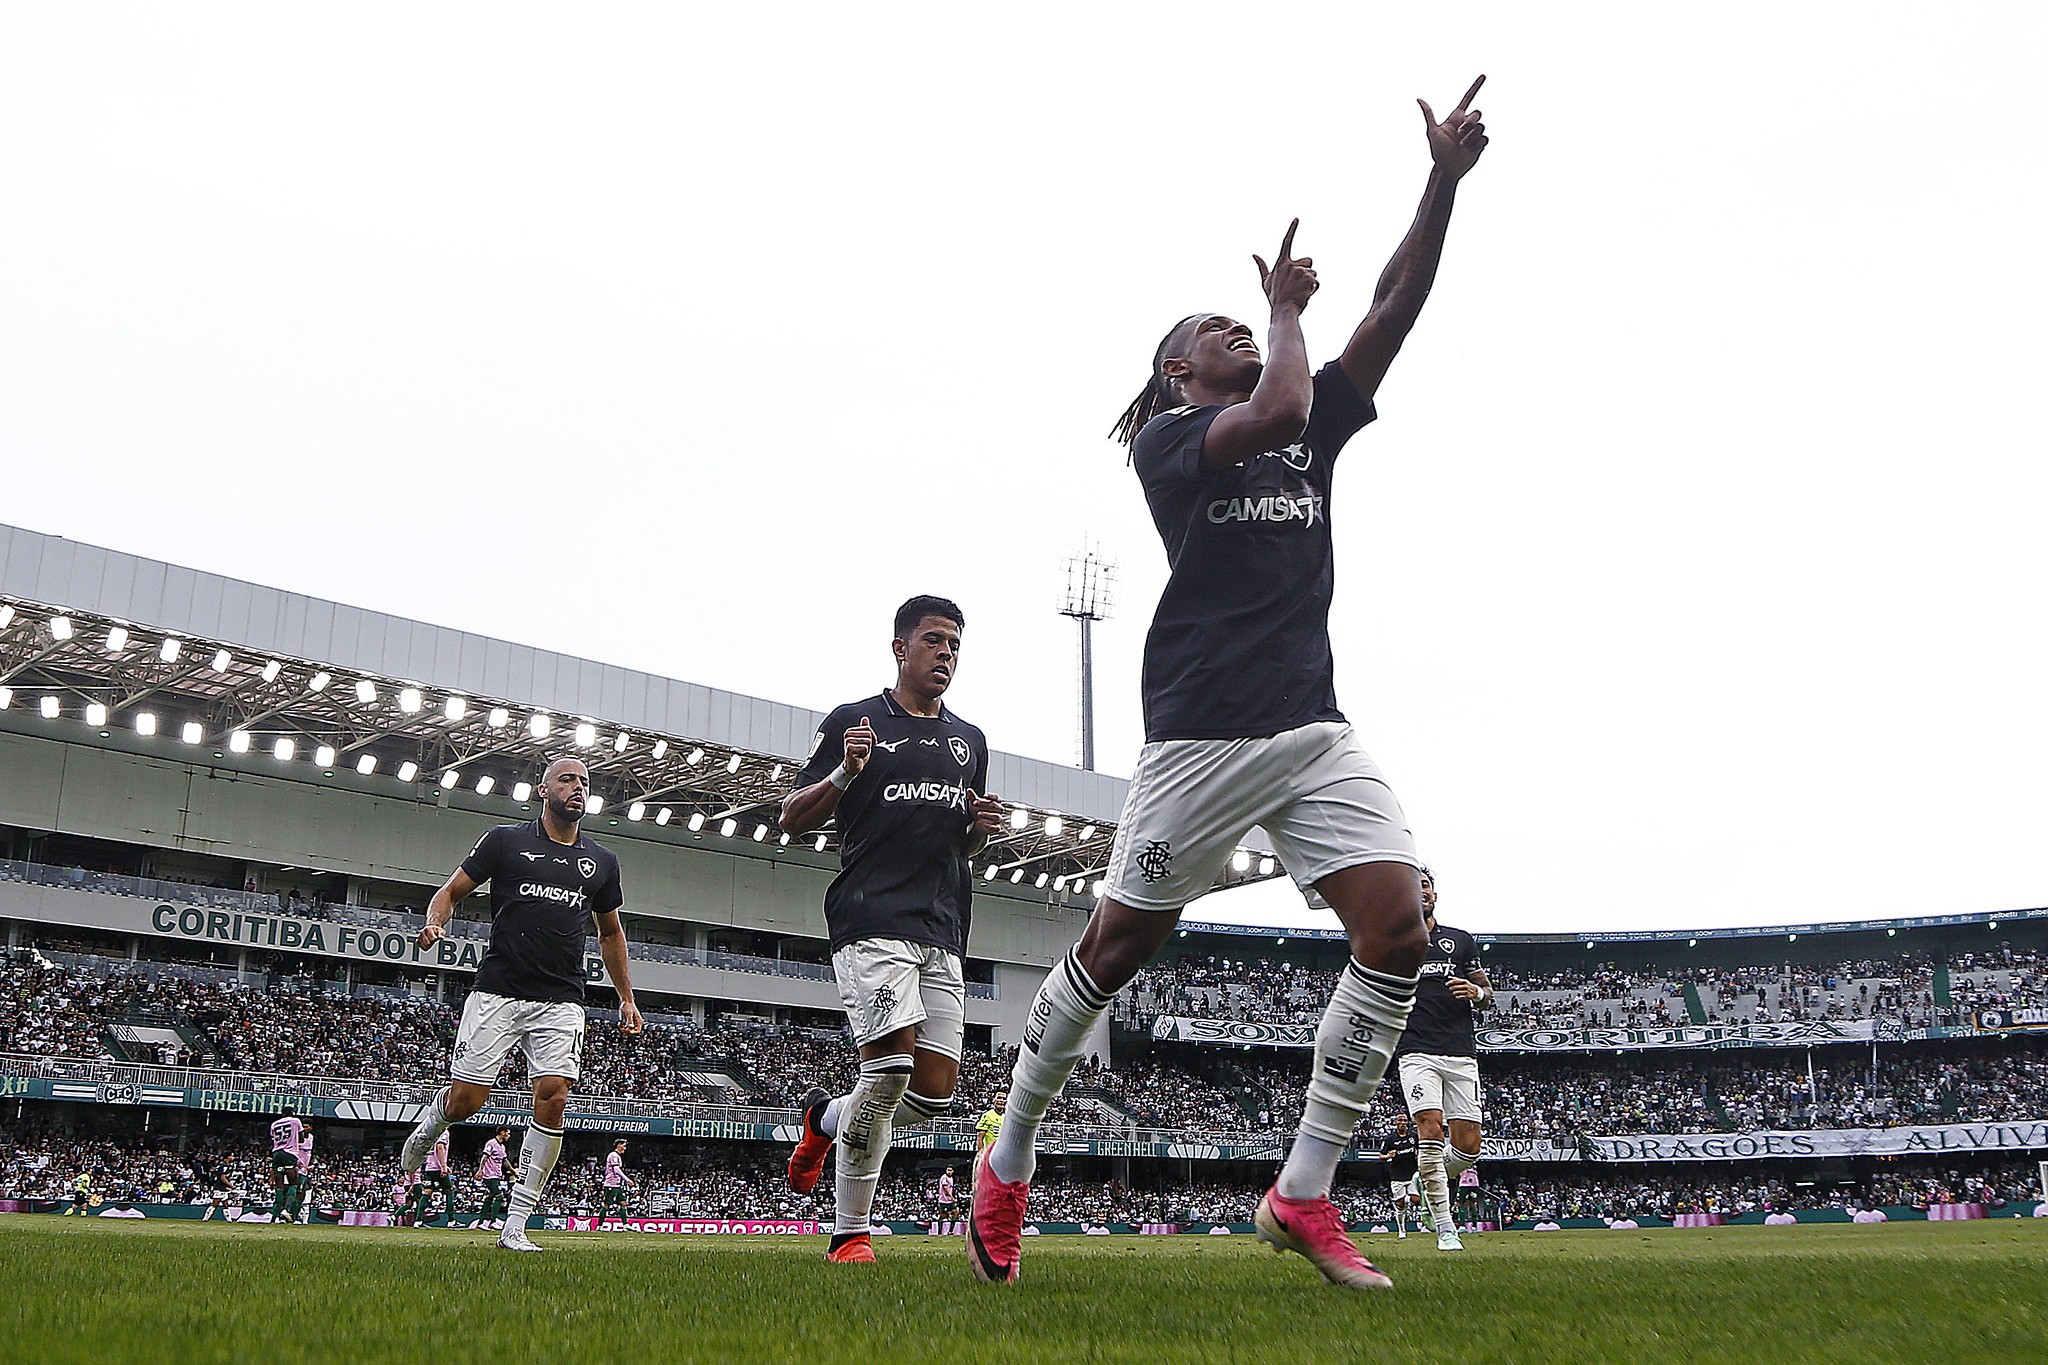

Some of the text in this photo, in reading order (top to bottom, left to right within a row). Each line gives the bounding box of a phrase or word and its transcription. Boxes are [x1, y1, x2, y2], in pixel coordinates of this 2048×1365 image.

[152, 904, 327, 951] CORITIBA
[1188, 1020, 1317, 1044] SOM
[106, 1087, 132, 1100] CFC
[200, 1089, 266, 1113] GREEN
[274, 1123, 292, 1141] 55
[464, 1110, 506, 1126] ESTÁDIO
[506, 1114, 534, 1128] MAJO
[582, 1118, 613, 1131] COUTO
[613, 1120, 650, 1133] PEREIRA
[672, 1119, 757, 1140] GREEN HELL
[1097, 1141, 1157, 1157] GREEN HELL
[751, 1224, 799, 1235] 2026
